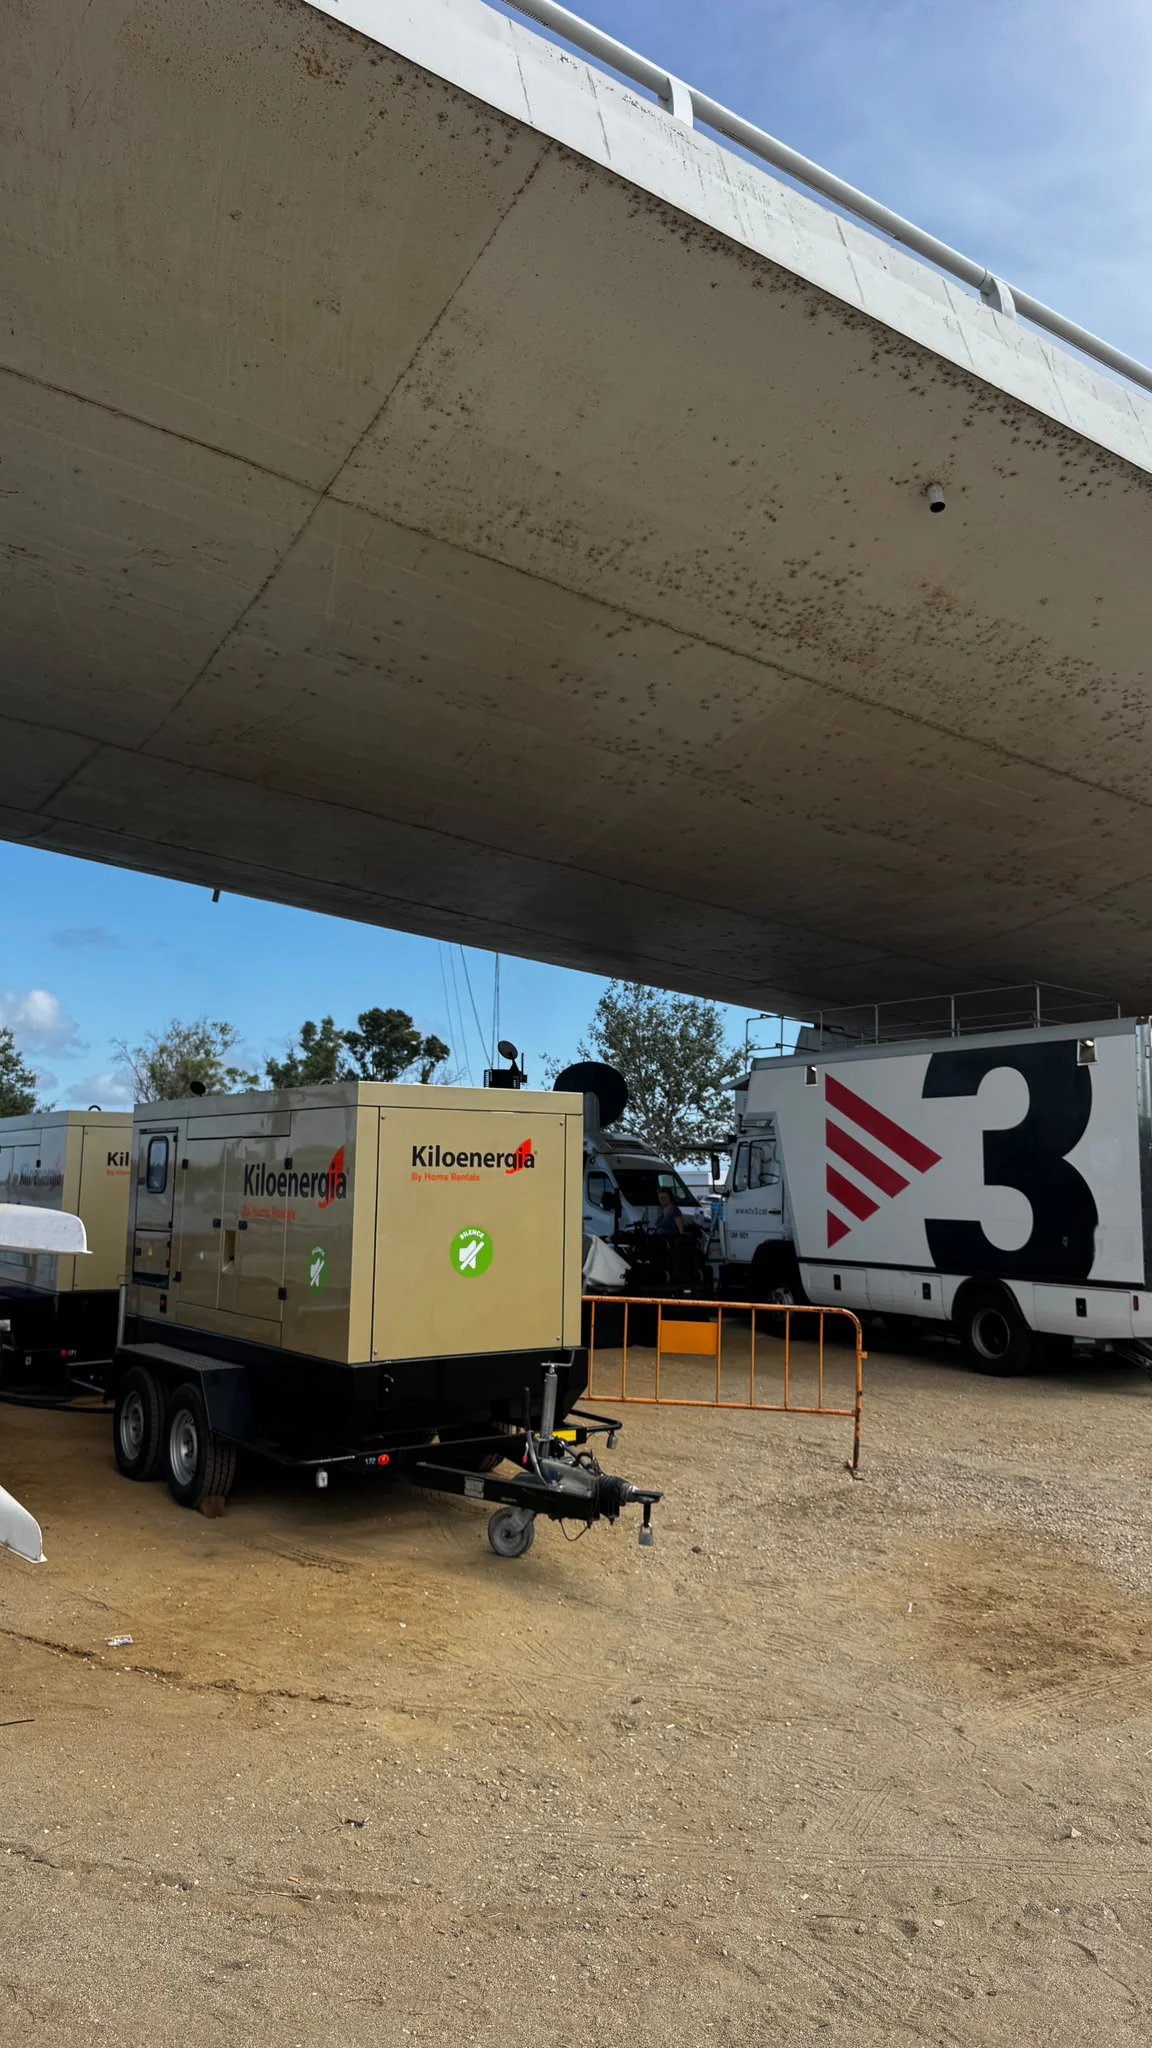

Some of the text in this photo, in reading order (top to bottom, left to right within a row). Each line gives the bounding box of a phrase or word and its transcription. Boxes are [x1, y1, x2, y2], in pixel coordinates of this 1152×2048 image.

[411, 1144, 536, 1175] Kiloenergia
[921, 1040, 1100, 1280] 3
[243, 1162, 347, 1209] Kiloenergia
[411, 1172, 422, 1183] By
[450, 1173, 481, 1182] Rentals
[459, 1229, 485, 1240] SILENCE
